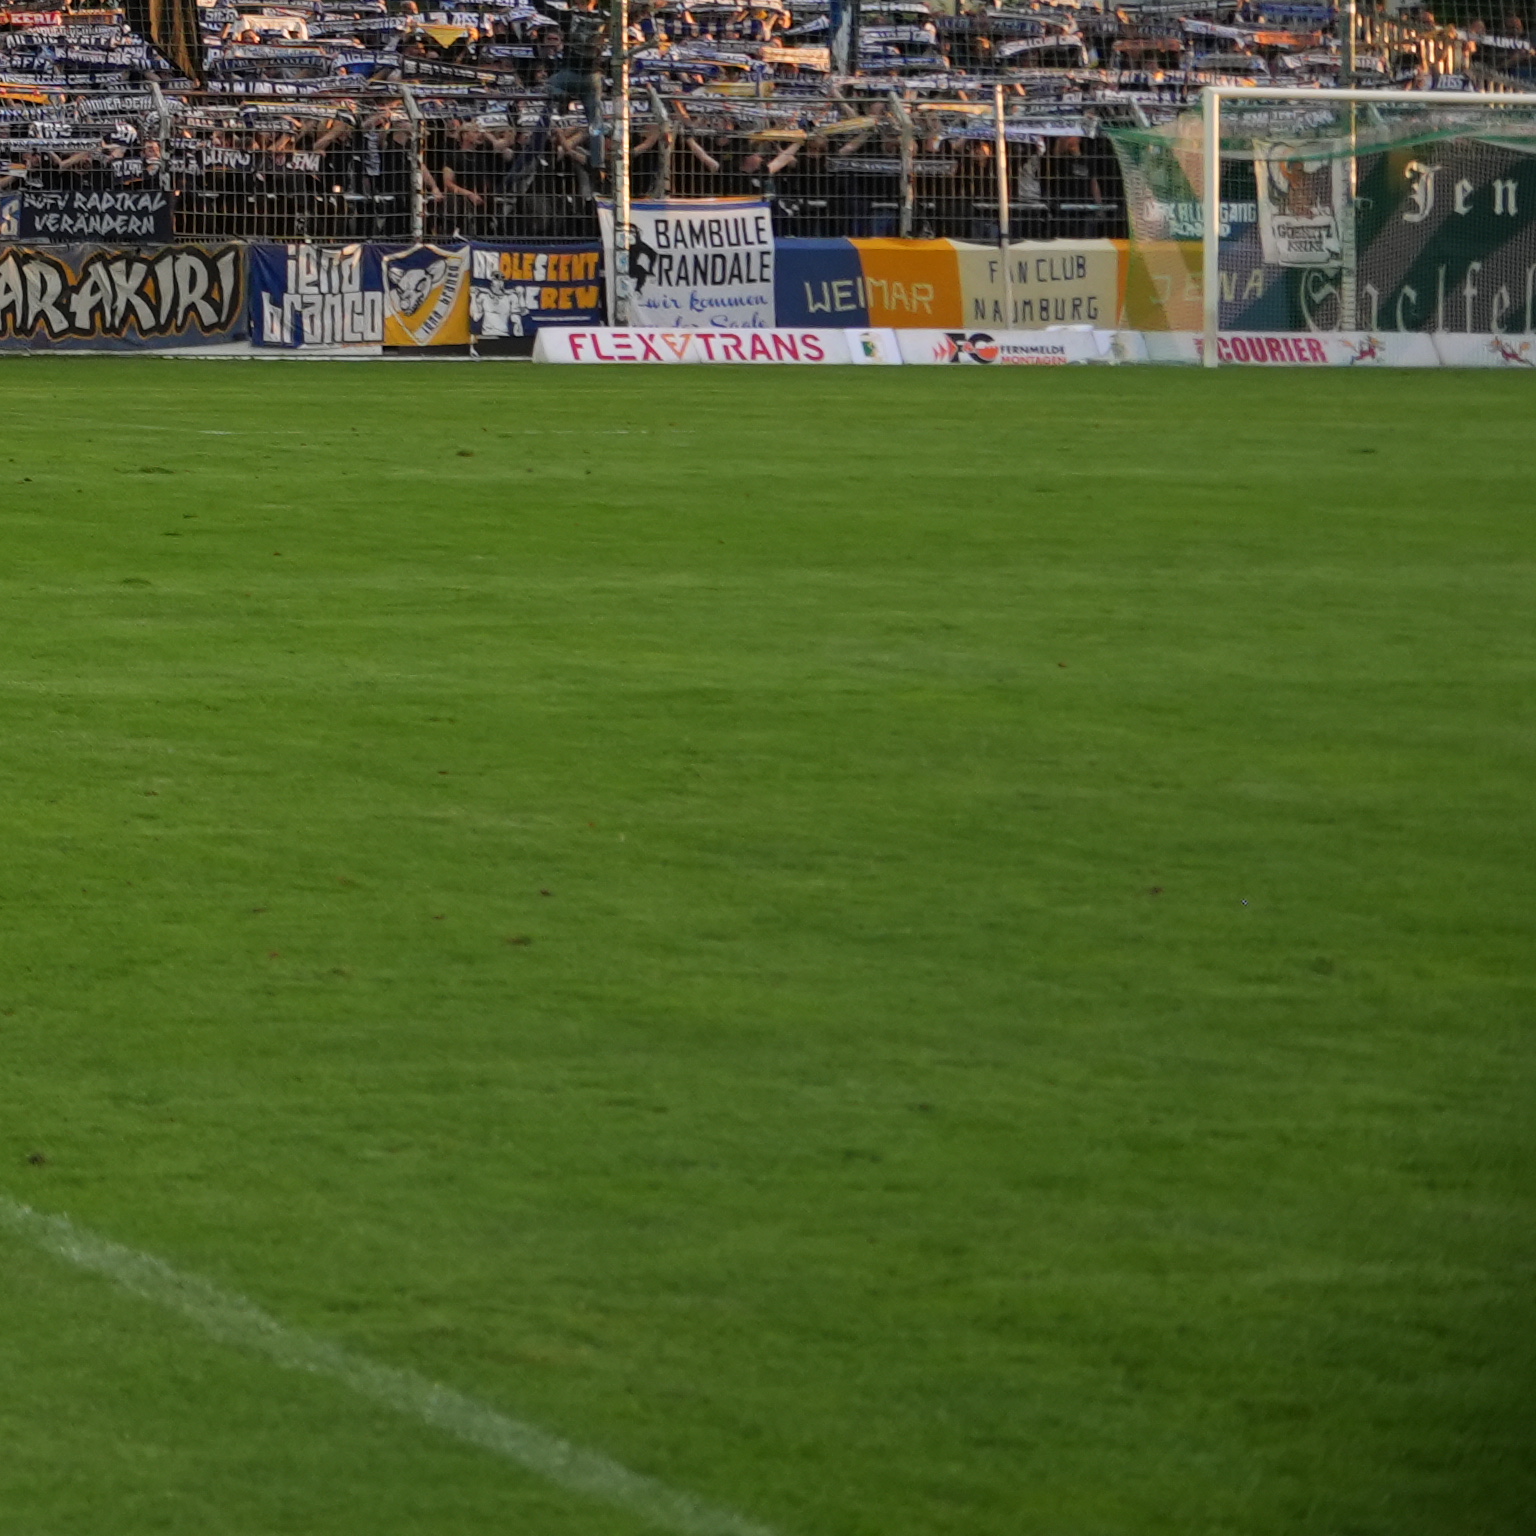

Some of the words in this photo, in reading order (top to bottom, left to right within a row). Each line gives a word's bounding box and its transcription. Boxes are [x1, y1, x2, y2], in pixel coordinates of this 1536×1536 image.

[73, 191, 168, 213] RADIKAL
[34, 212, 156, 236] VERÄNDERN
[656, 215, 769, 250] BAMBULE
[657, 250, 772, 287] RANDALE
[1036, 254, 1088, 284] CLUB
[689, 289, 769, 313] kommen
[804, 275, 934, 314] WEIMAR
[568, 333, 664, 362] FLEX
[695, 333, 825, 362] TRANS
[1217, 337, 1329, 363] COURIER
